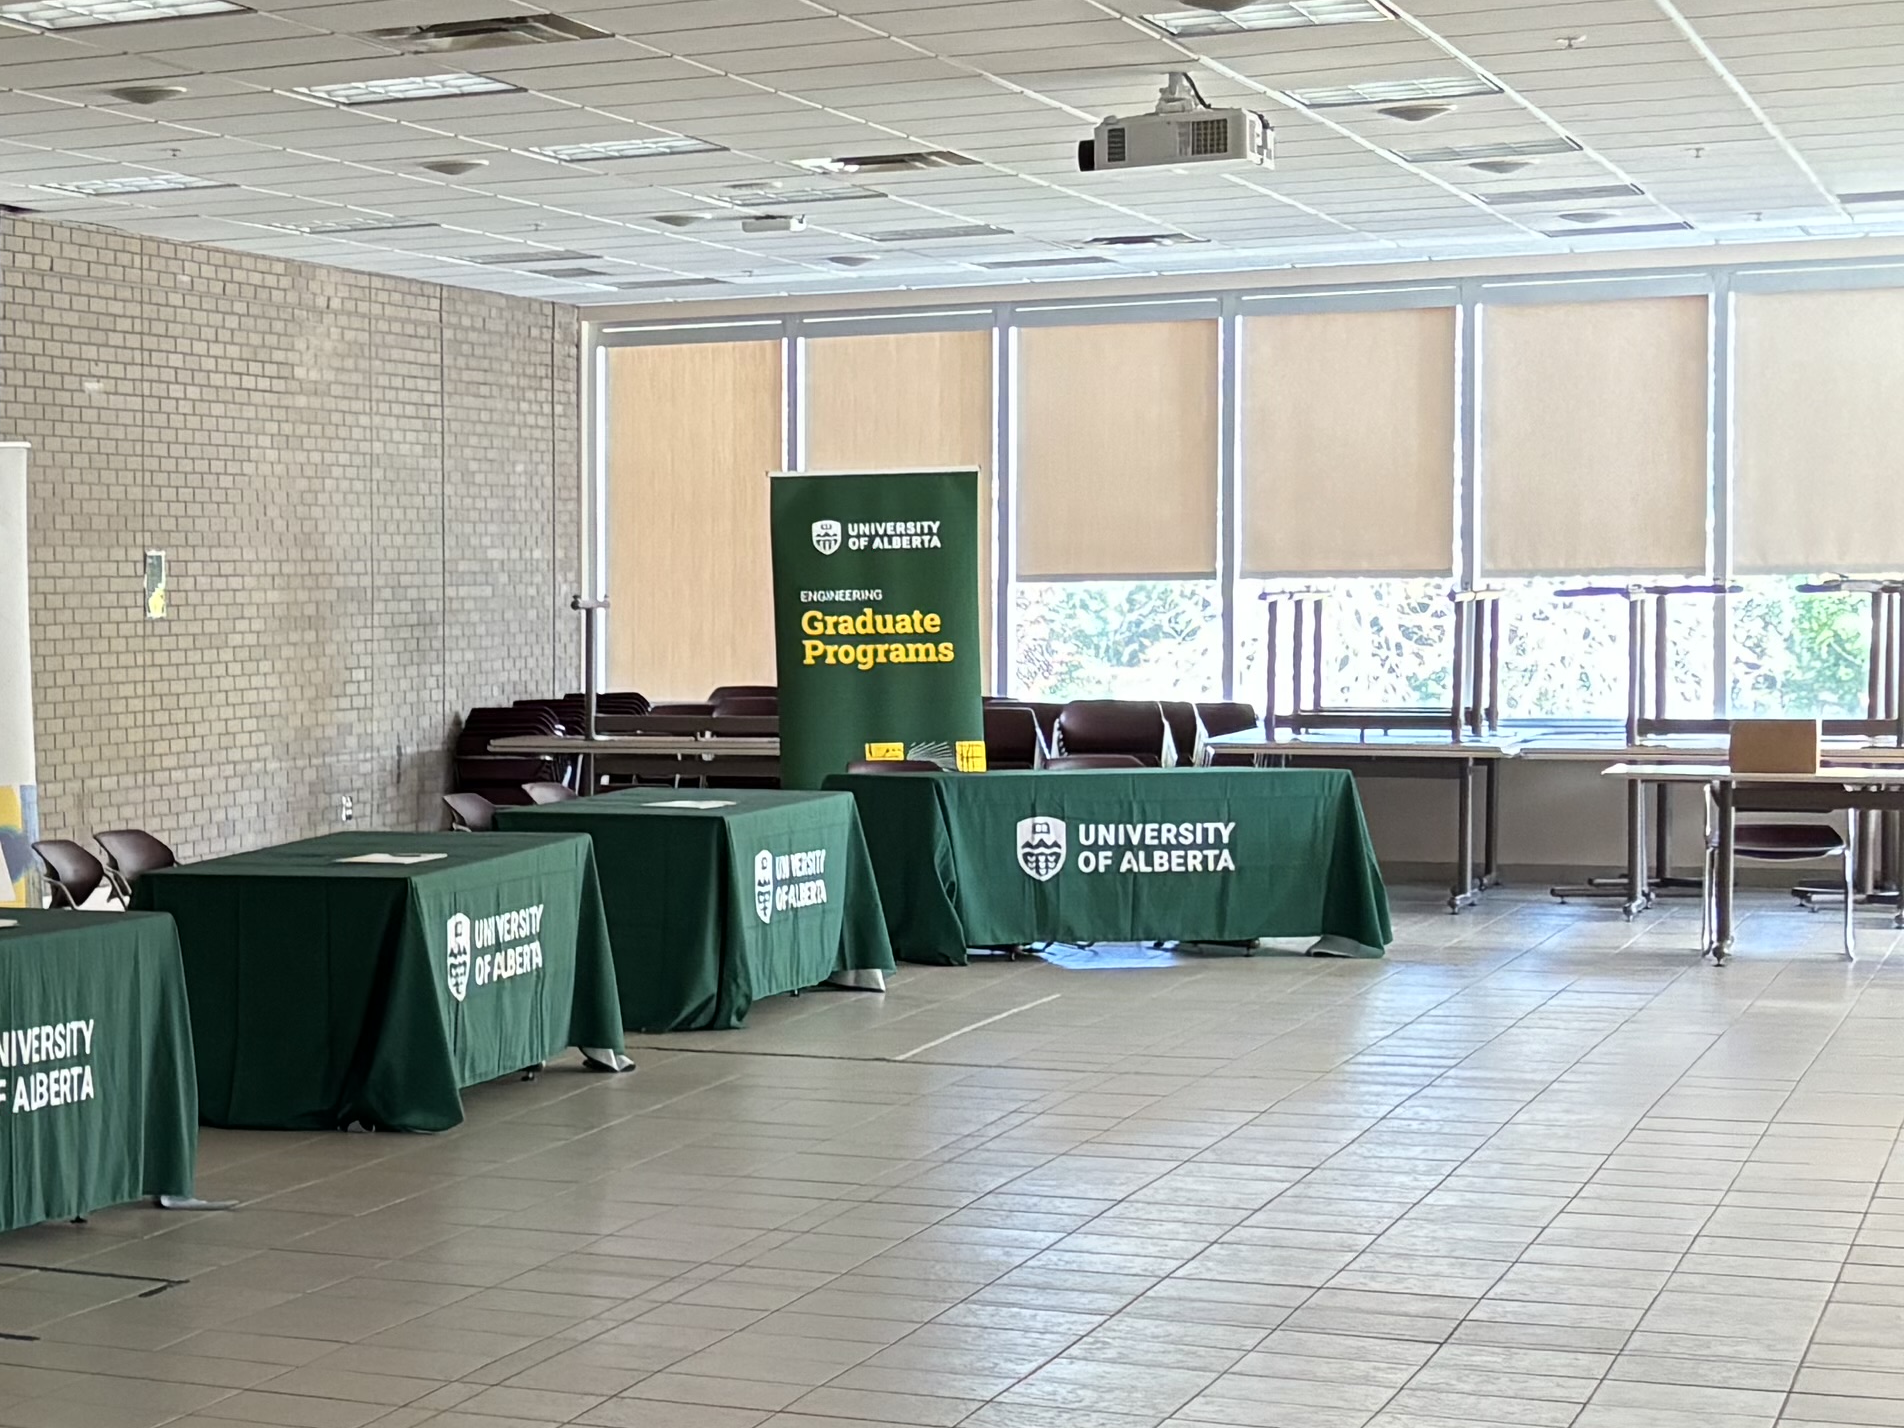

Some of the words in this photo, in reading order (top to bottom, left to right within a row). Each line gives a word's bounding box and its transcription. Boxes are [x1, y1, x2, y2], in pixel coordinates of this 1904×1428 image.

[848, 521, 940, 535] UNIVERSITY
[848, 537, 869, 550] OF
[872, 535, 941, 550] ALBERTA
[800, 589, 883, 602] ENGINEERING
[801, 607, 941, 635] Graduate
[802, 639, 955, 670] Programs
[1079, 822, 1236, 846] UNIVERSITY
[1078, 850, 1113, 873] OF
[1119, 848, 1236, 873] ALBERTA
[475, 904, 544, 949] UNIVERSITY
[475, 956, 491, 986] OF
[493, 940, 543, 982] ALBERTA
[12, 1065, 95, 1114] ALBERTA
